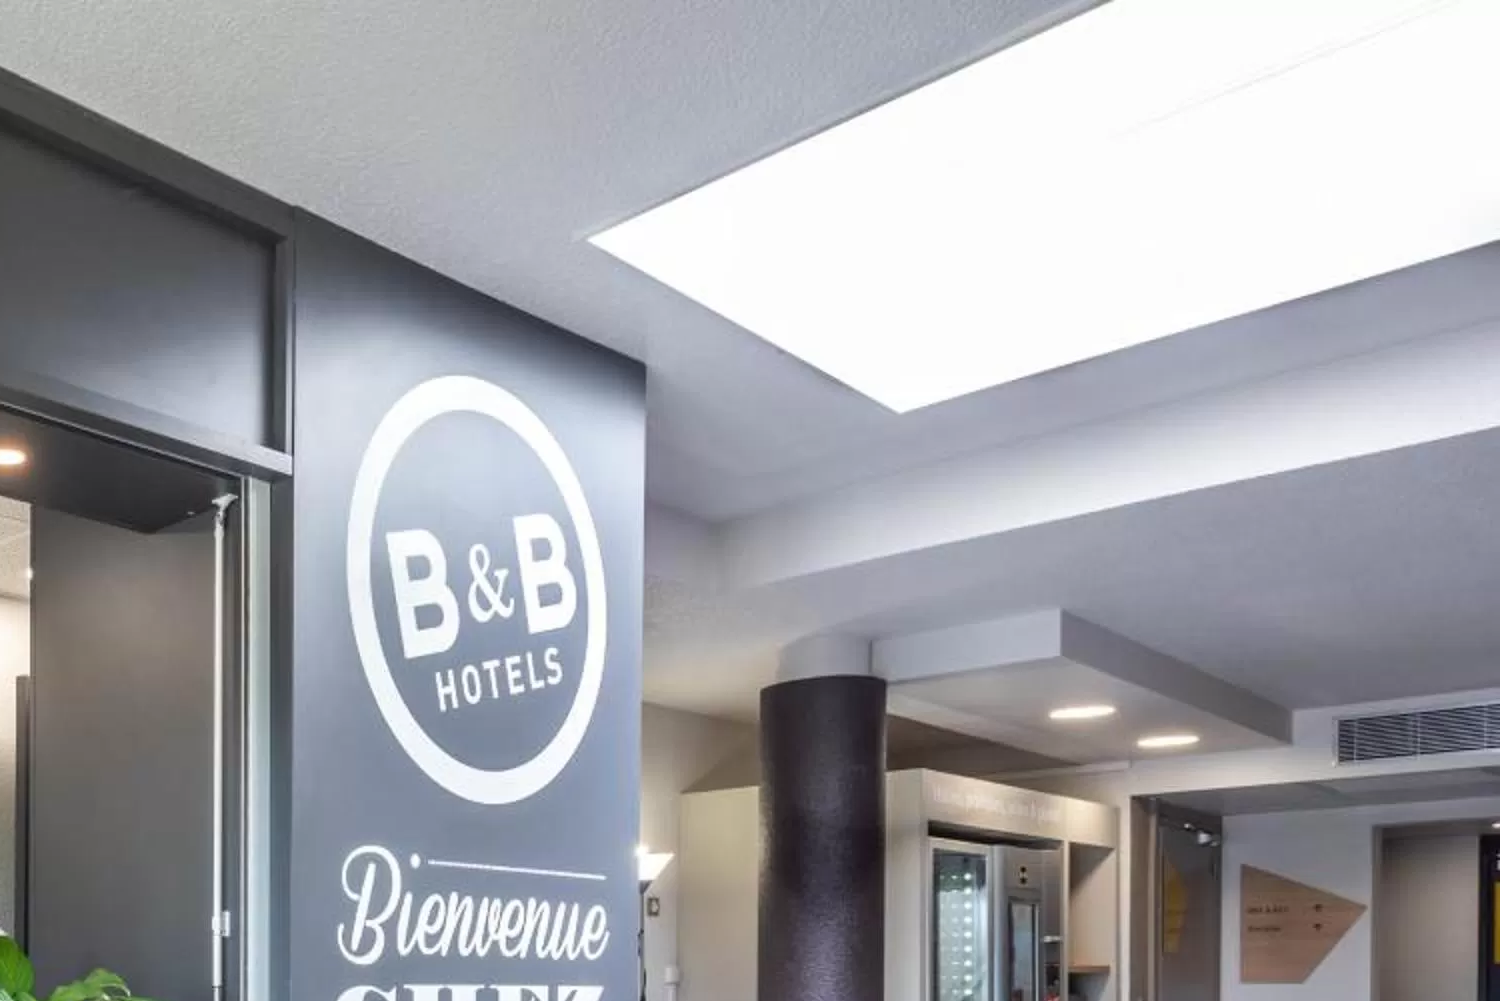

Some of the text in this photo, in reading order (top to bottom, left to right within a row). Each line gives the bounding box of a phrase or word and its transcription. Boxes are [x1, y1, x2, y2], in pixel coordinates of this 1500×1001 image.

[385, 513, 577, 659] B&B
[434, 647, 564, 713] HOTELS
[337, 845, 610, 966] Bienvenue
